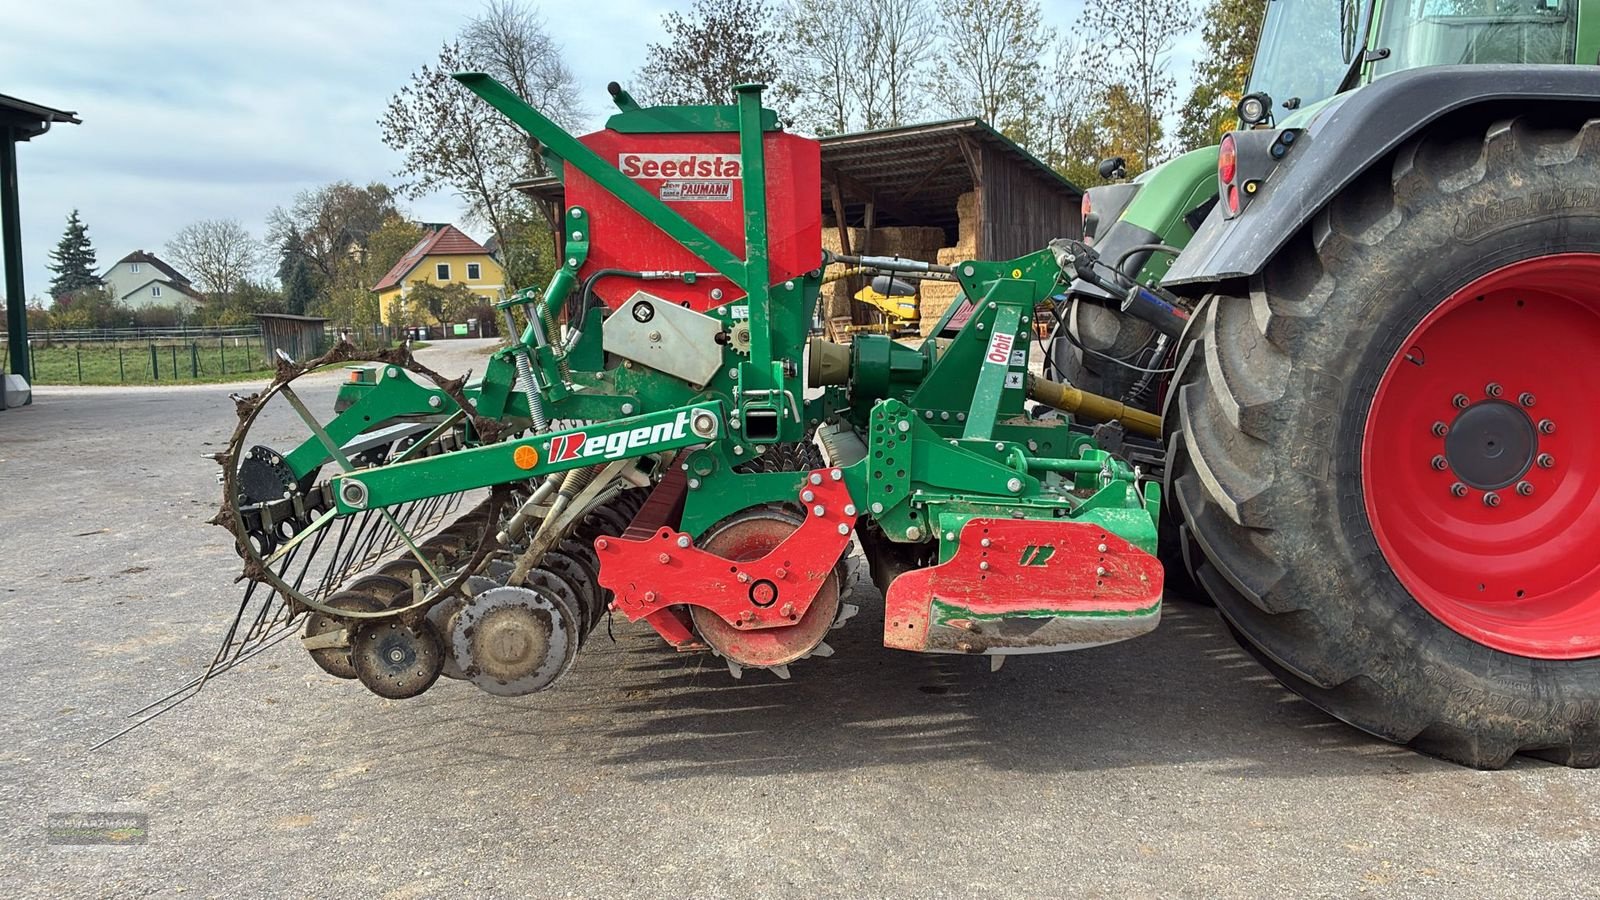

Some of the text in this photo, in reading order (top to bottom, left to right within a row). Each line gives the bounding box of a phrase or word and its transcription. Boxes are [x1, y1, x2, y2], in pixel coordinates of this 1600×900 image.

[622, 155, 741, 178] Seedsta
[680, 183, 730, 196] PAUMANN
[988, 334, 1012, 362] Orbit
[547, 411, 690, 464] Regent
